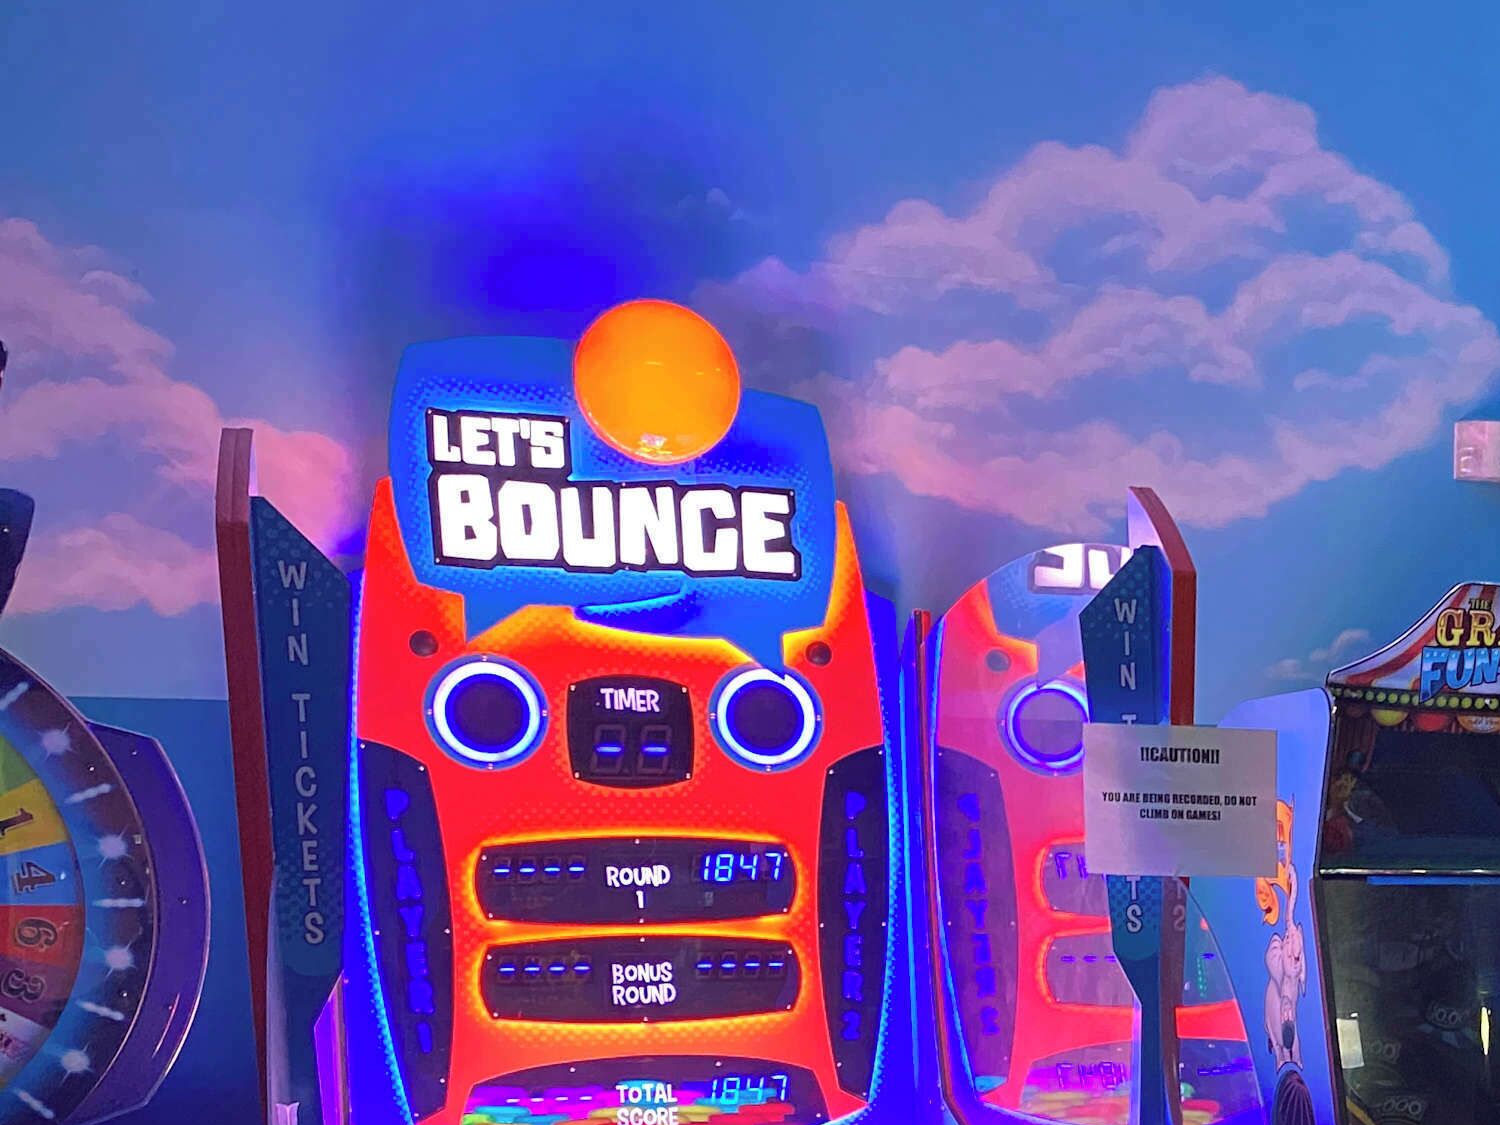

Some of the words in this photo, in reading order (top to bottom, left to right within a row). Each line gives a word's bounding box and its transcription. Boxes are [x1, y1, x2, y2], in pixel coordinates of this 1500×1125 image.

[433, 414, 565, 469] LET'S
[437, 474, 796, 575] BOUNCE
[277, 559, 309, 667] WIN
[1114, 597, 1137, 691] WIN
[600, 687, 661, 713] TIMER
[1102, 791, 1121, 802] YOU
[1123, 792, 1141, 804] ARE
[1142, 793, 1171, 804] BEING
[1172, 793, 1222, 807] RECORDED,
[1224, 795, 1237, 806] DO
[1239, 796, 1257, 807] NOT
[291, 692, 326, 945] TICKETS
[1140, 808, 1170, 820] CLIMB
[1171, 809, 1184, 820] ON
[1186, 810, 1222, 821] GAMES!
[13, 861, 57, 897] 4
[606, 865, 671, 888] ROUND
[703, 852, 783, 883] 1847
[635, 891, 644, 909] 1
[611, 962, 673, 984] BONUS
[611, 984, 676, 1006] ROUND
[616, 1083, 678, 1104] TOTAL
[710, 1074, 789, 1104] 1847
